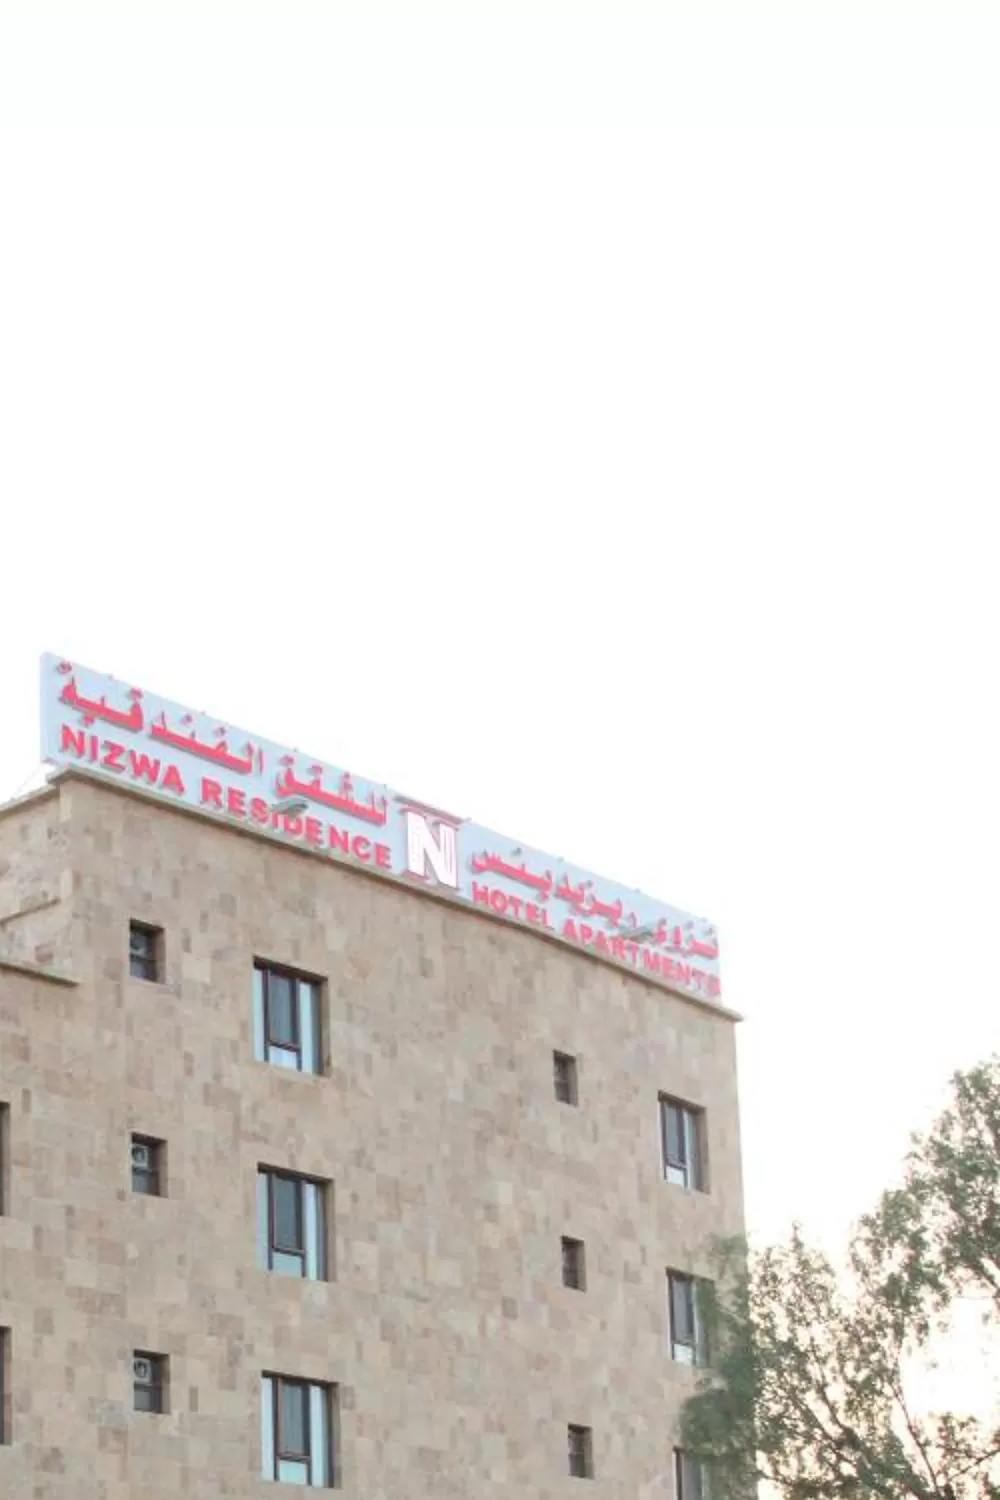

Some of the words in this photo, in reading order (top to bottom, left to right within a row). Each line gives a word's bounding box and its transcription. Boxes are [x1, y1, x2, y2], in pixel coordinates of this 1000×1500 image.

[60, 722, 186, 797] NIZWA
[201, 775, 393, 870] RESIDENCE
[398, 794, 463, 891] N
[471, 880, 551, 931] HOTEL
[562, 918, 722, 997] APARTMENTS
